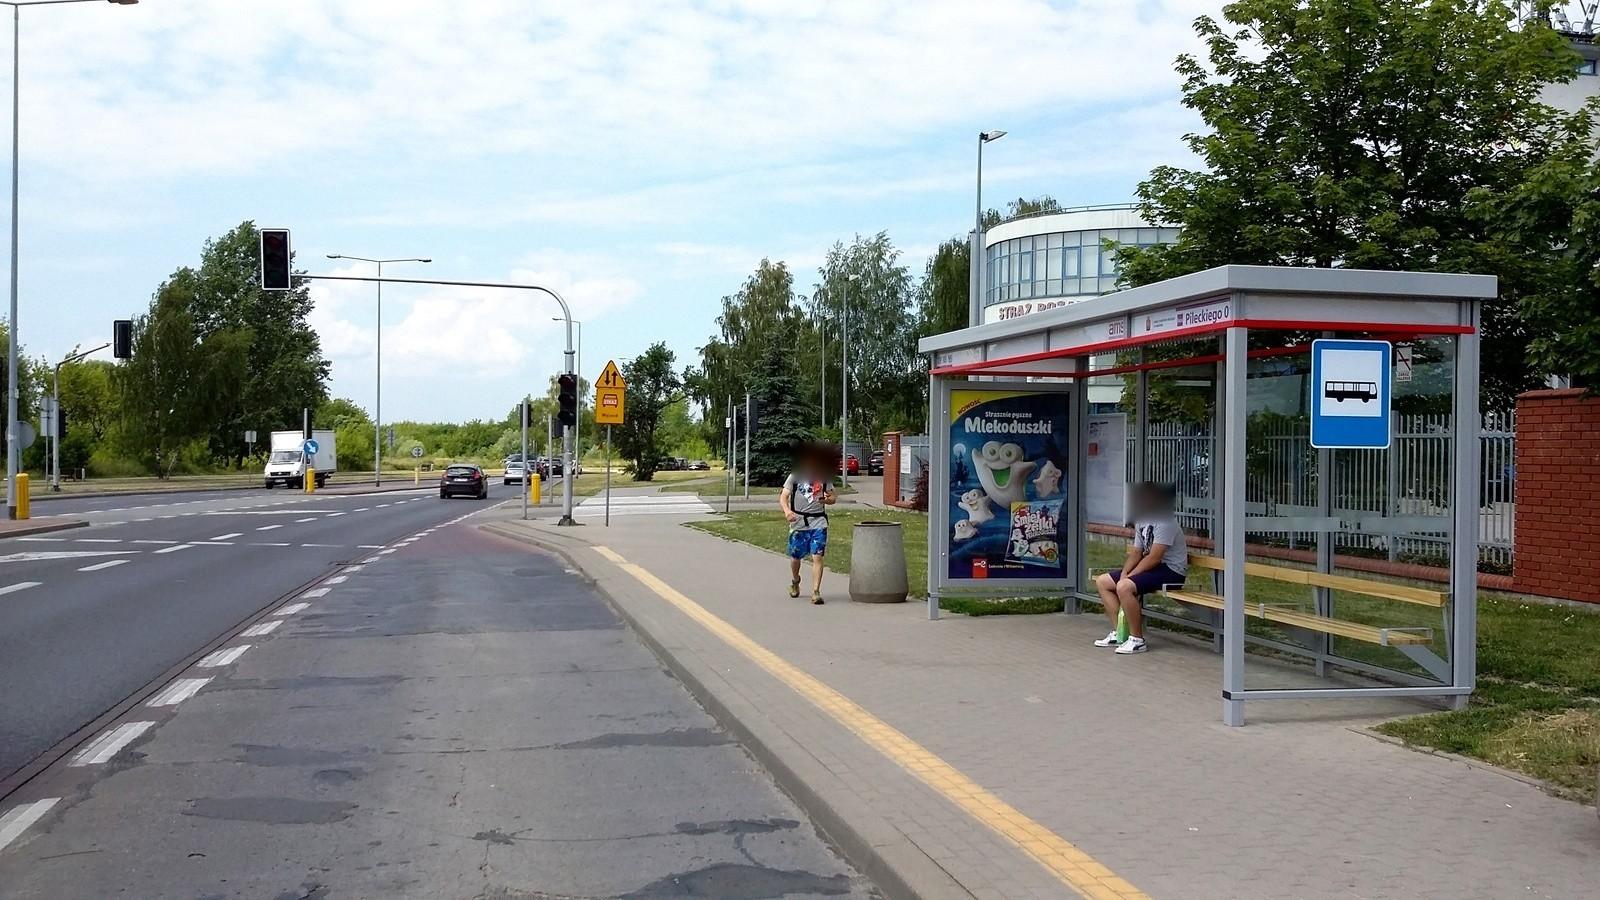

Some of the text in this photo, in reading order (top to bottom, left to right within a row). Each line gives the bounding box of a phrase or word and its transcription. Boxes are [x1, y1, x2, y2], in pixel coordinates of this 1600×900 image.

[1185, 308, 1223, 325] Pileckiego
[1108, 320, 1124, 335] ams
[1011, 411, 1033, 419] pyszne
[964, 416, 1052, 434] Mlekoduszki
